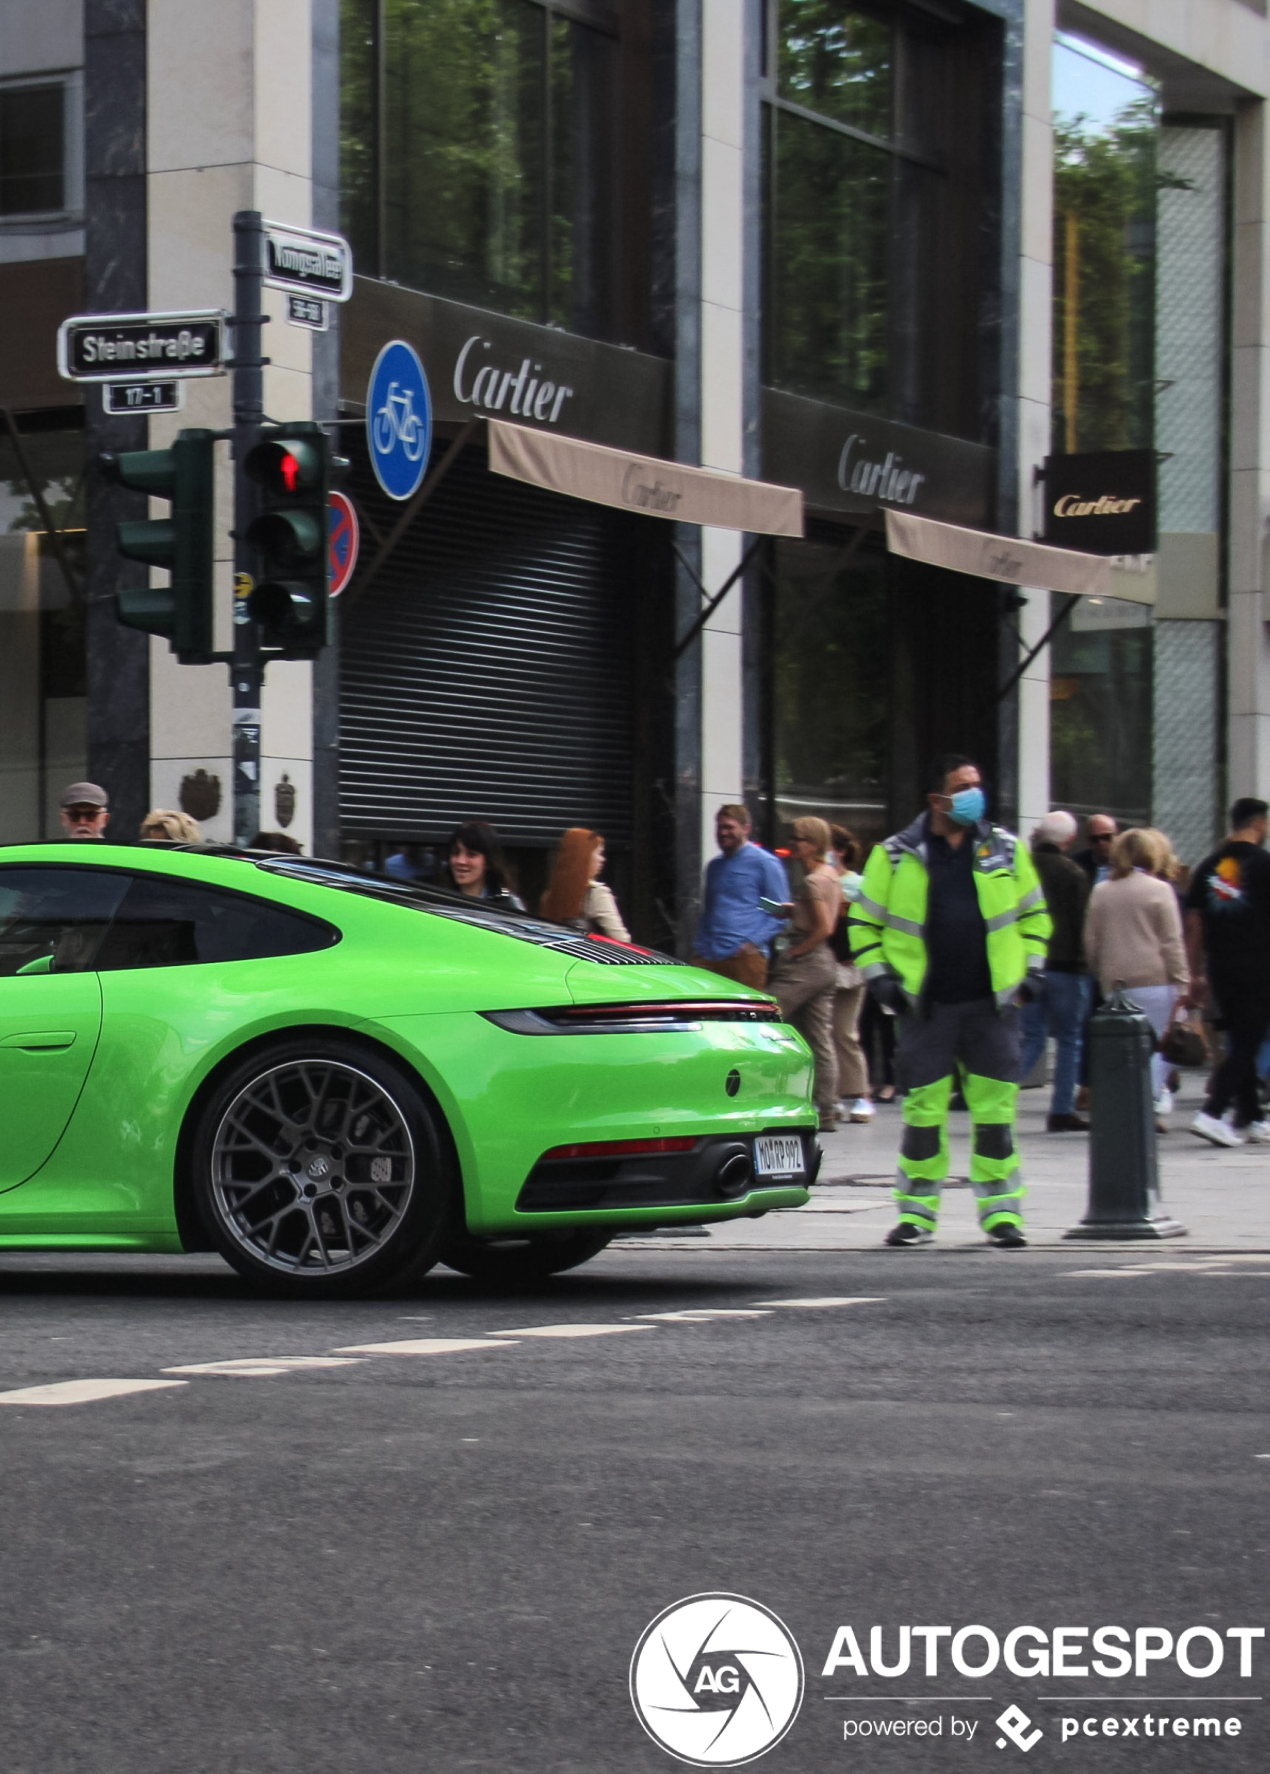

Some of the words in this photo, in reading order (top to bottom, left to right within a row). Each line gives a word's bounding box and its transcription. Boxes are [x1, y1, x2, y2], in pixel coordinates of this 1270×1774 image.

[83, 330, 205, 362] Steinstraße
[453, 336, 572, 422] Cartier
[125, 387, 161, 405] 17-1
[838, 434, 925, 504] Cartier
[1053, 493, 1141, 519] Cartier
